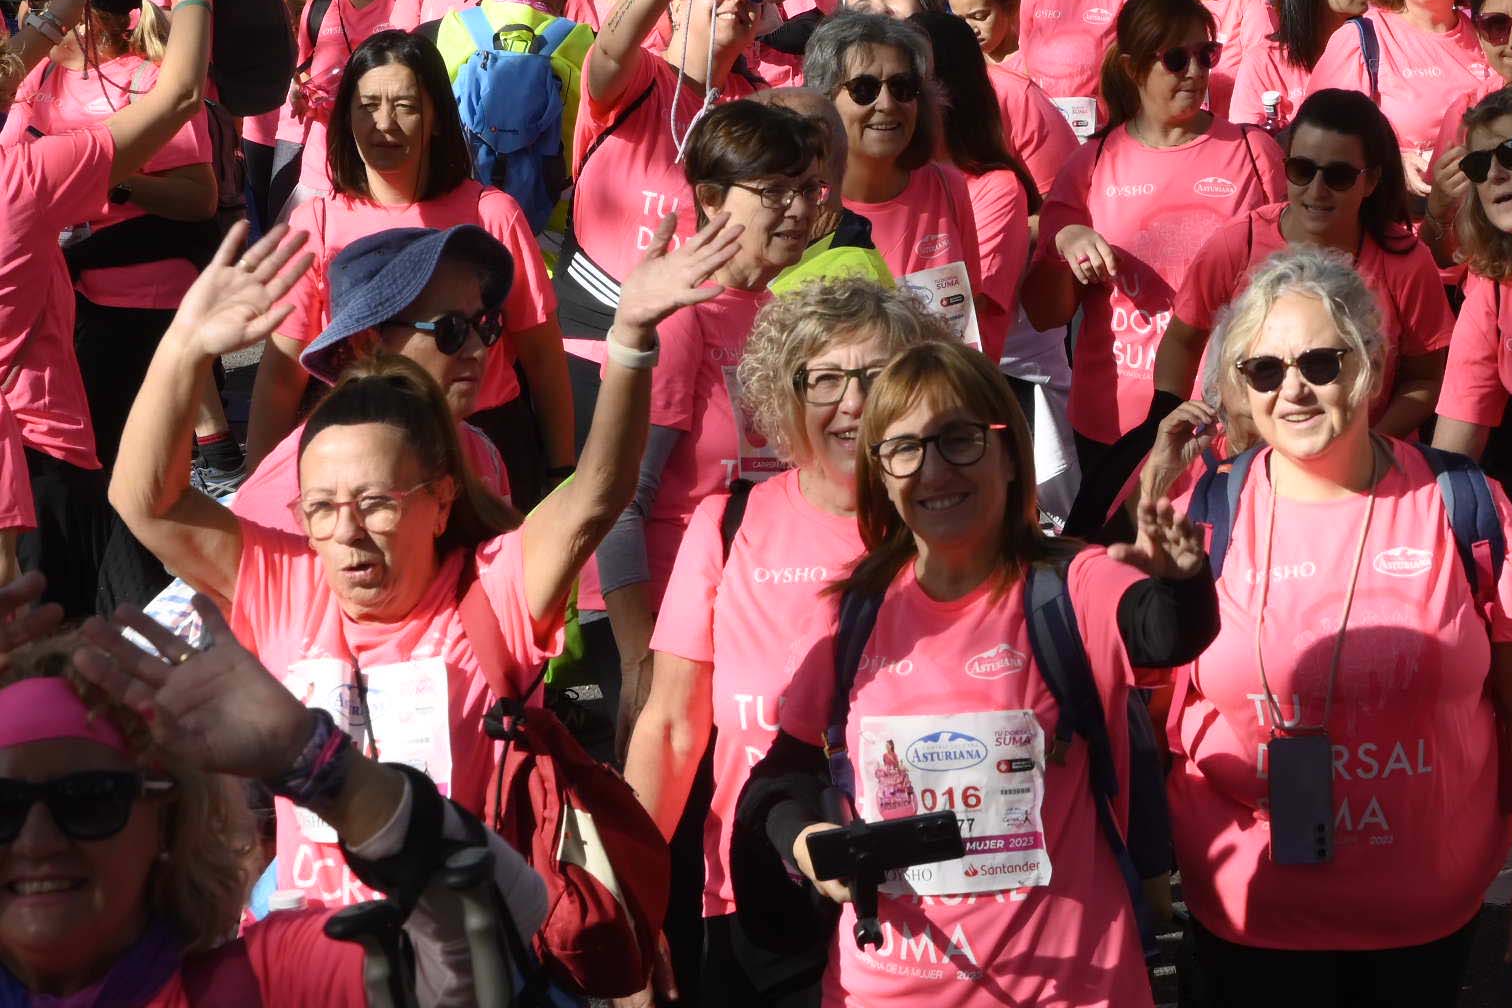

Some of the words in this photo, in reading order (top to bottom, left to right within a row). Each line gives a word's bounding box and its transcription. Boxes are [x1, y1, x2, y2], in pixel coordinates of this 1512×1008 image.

[1106, 183, 1154, 198] OYSHO
[753, 567, 827, 584] OYSHO
[995, 736, 1032, 747] SUMA
[912, 747, 982, 764] ASTURIANA
[920, 785, 982, 811] 016
[966, 840, 1005, 852] MUJER
[1008, 836, 1034, 848] 2023
[980, 860, 1040, 878] Santander
